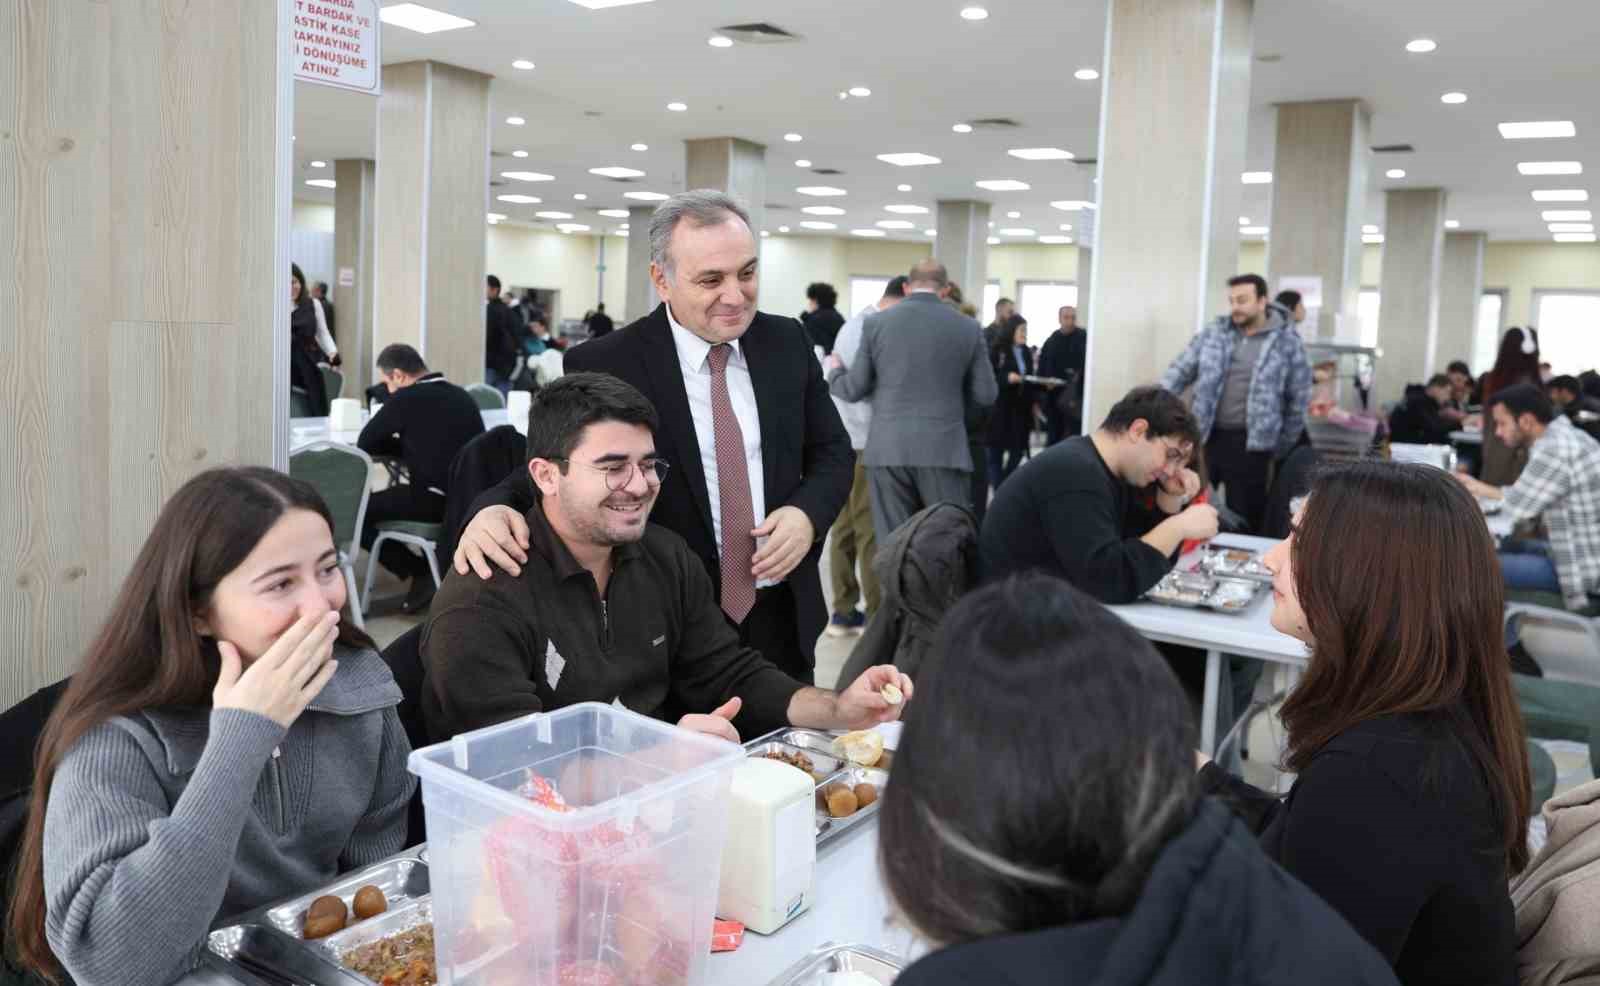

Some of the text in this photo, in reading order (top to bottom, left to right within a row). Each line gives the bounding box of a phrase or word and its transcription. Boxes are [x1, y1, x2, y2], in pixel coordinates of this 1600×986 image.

[308, 3, 354, 23] BARDAK
[356, 15, 370, 28] VE
[302, 61, 341, 77] ATINIZ
